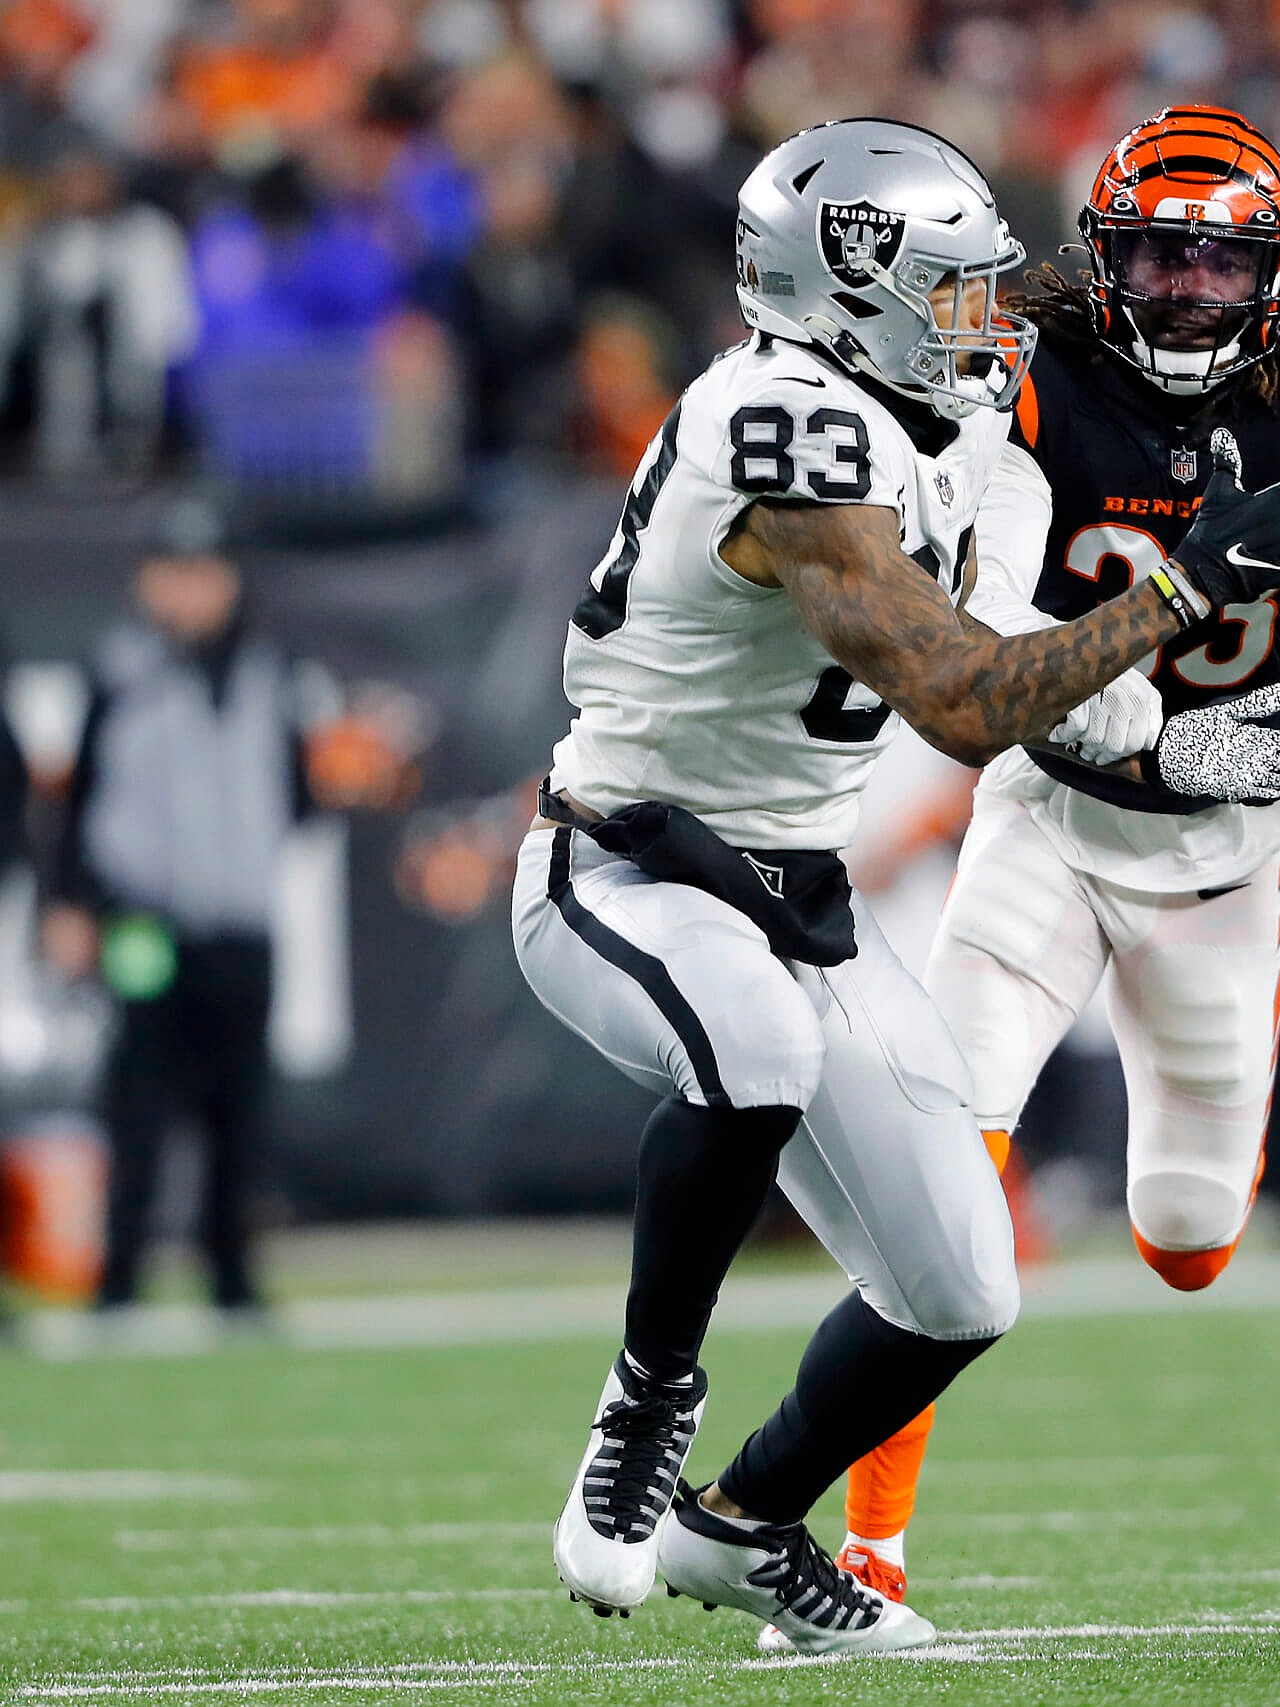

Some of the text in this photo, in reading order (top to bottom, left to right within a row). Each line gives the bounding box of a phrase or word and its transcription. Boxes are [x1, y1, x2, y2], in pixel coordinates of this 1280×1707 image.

[829, 206, 898, 224] RAIDERS
[730, 405, 872, 500] 83
[1175, 463, 1194, 476] NFL
